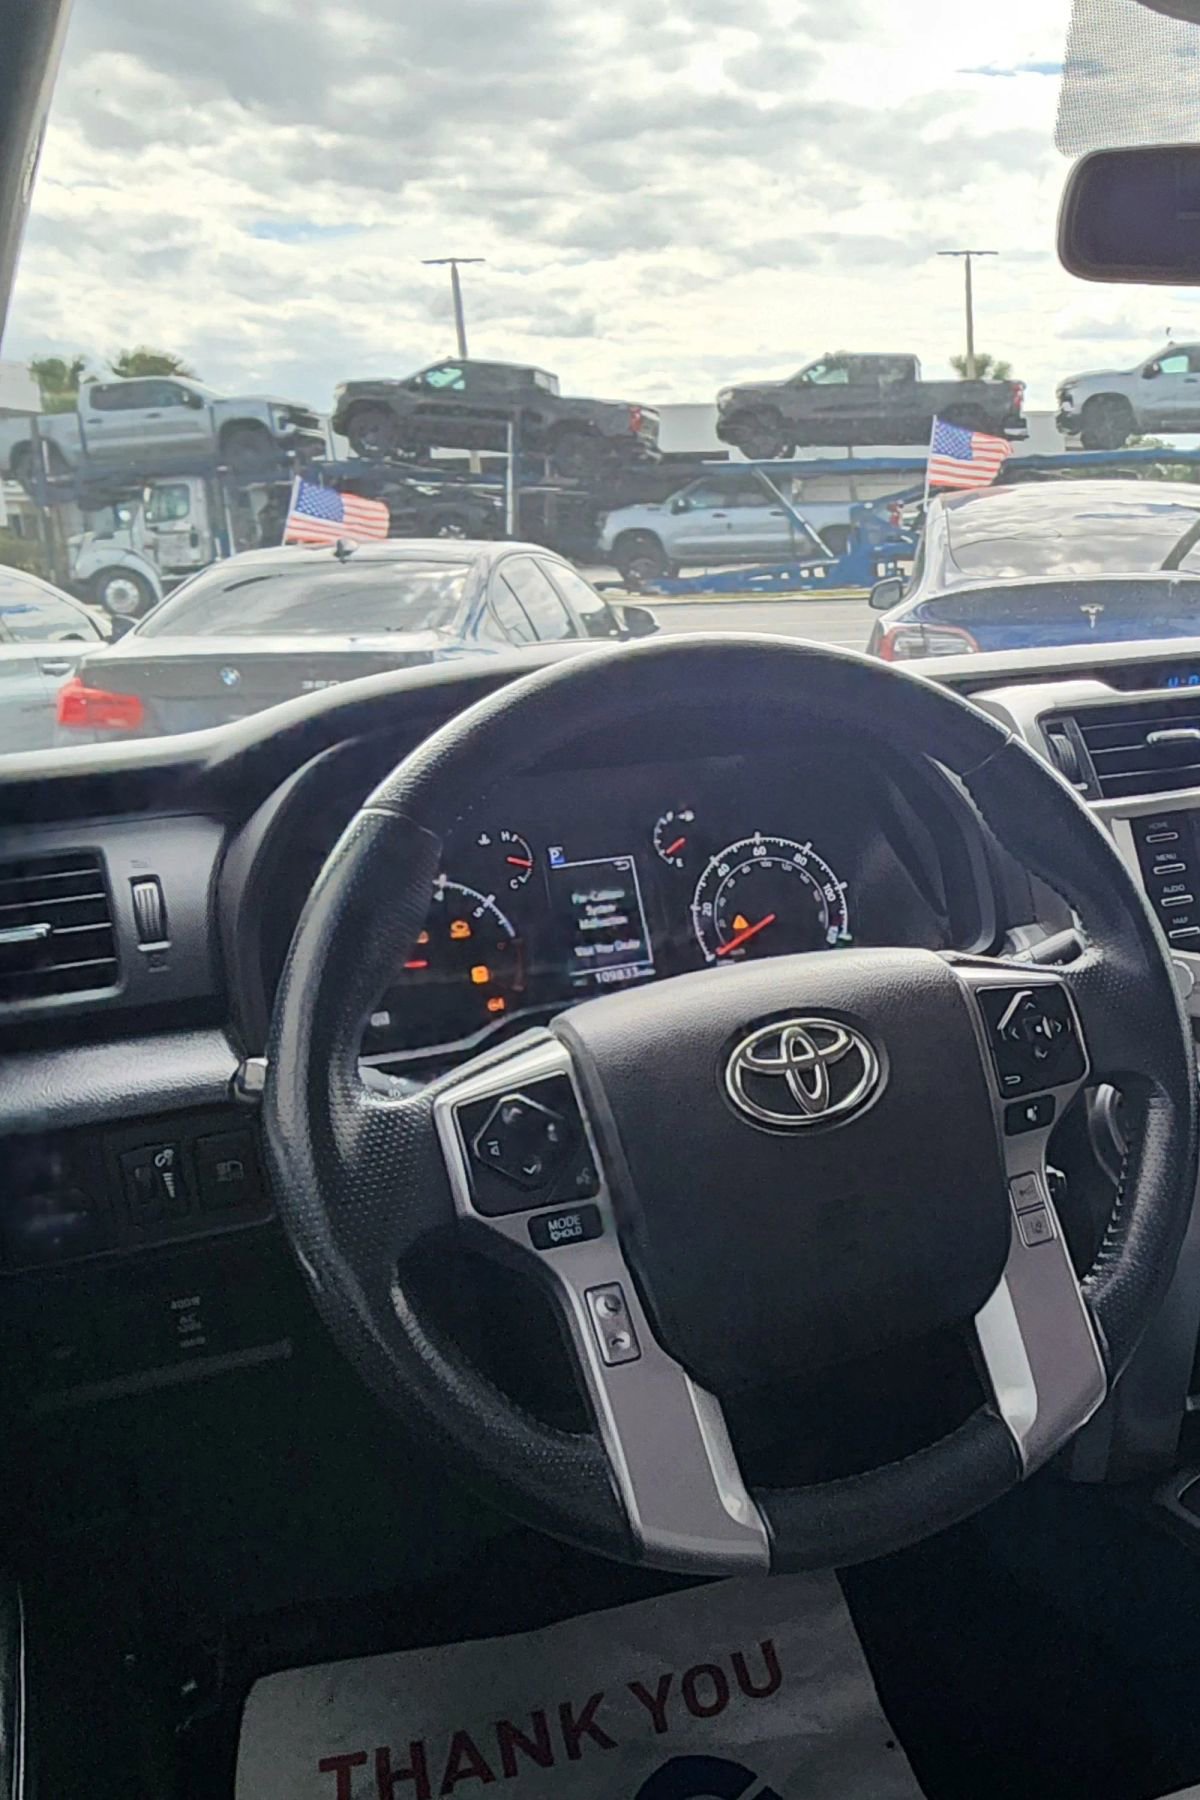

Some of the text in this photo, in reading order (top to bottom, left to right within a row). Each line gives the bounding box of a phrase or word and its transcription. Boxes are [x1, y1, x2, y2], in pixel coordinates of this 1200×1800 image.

[1155, 853, 1177, 861] MENU
[1163, 884, 1186, 893] AUDIO
[548, 1214, 582, 1231] MODE
[318, 1638, 785, 1800] THANK YOU
